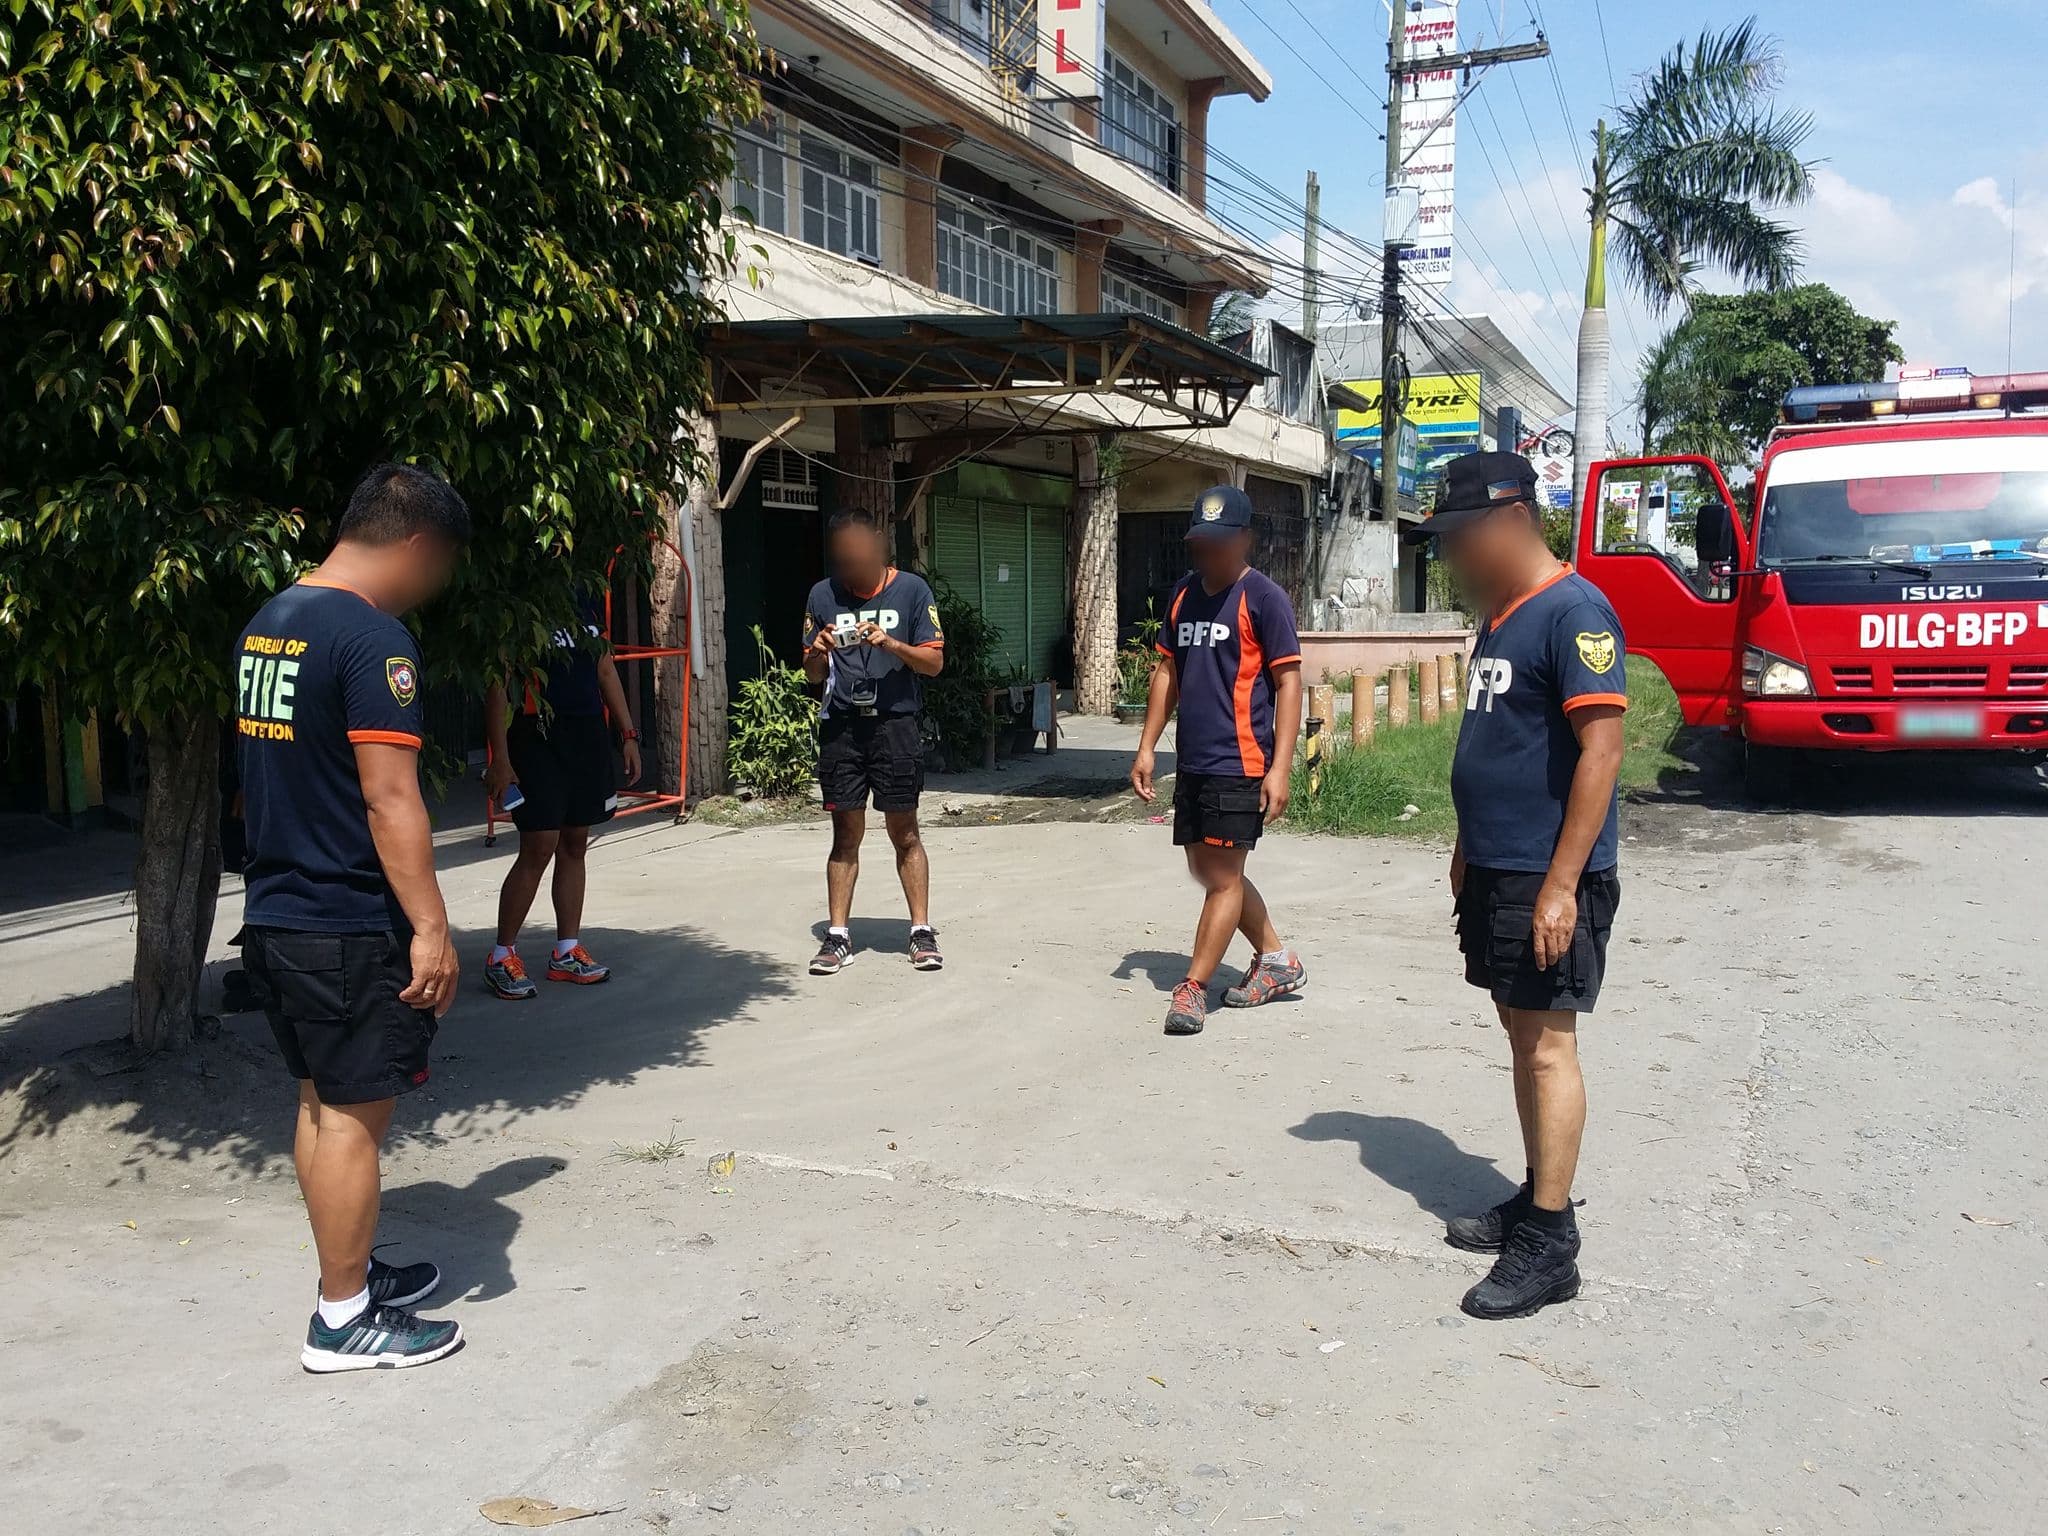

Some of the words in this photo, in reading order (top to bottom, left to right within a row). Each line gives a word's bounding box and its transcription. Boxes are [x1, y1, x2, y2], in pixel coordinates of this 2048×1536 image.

[1404, 20, 1455, 34] MPUTERS
[1407, 163, 1453, 175] ORCYCLES
[1901, 585, 1983, 600] ISUZU
[1178, 621, 1230, 648] BFP
[1860, 612, 2028, 649] DILG-BFP
[244, 635, 285, 655] BUREAU
[285, 639, 309, 657] OF
[238, 655, 300, 721] FIRE
